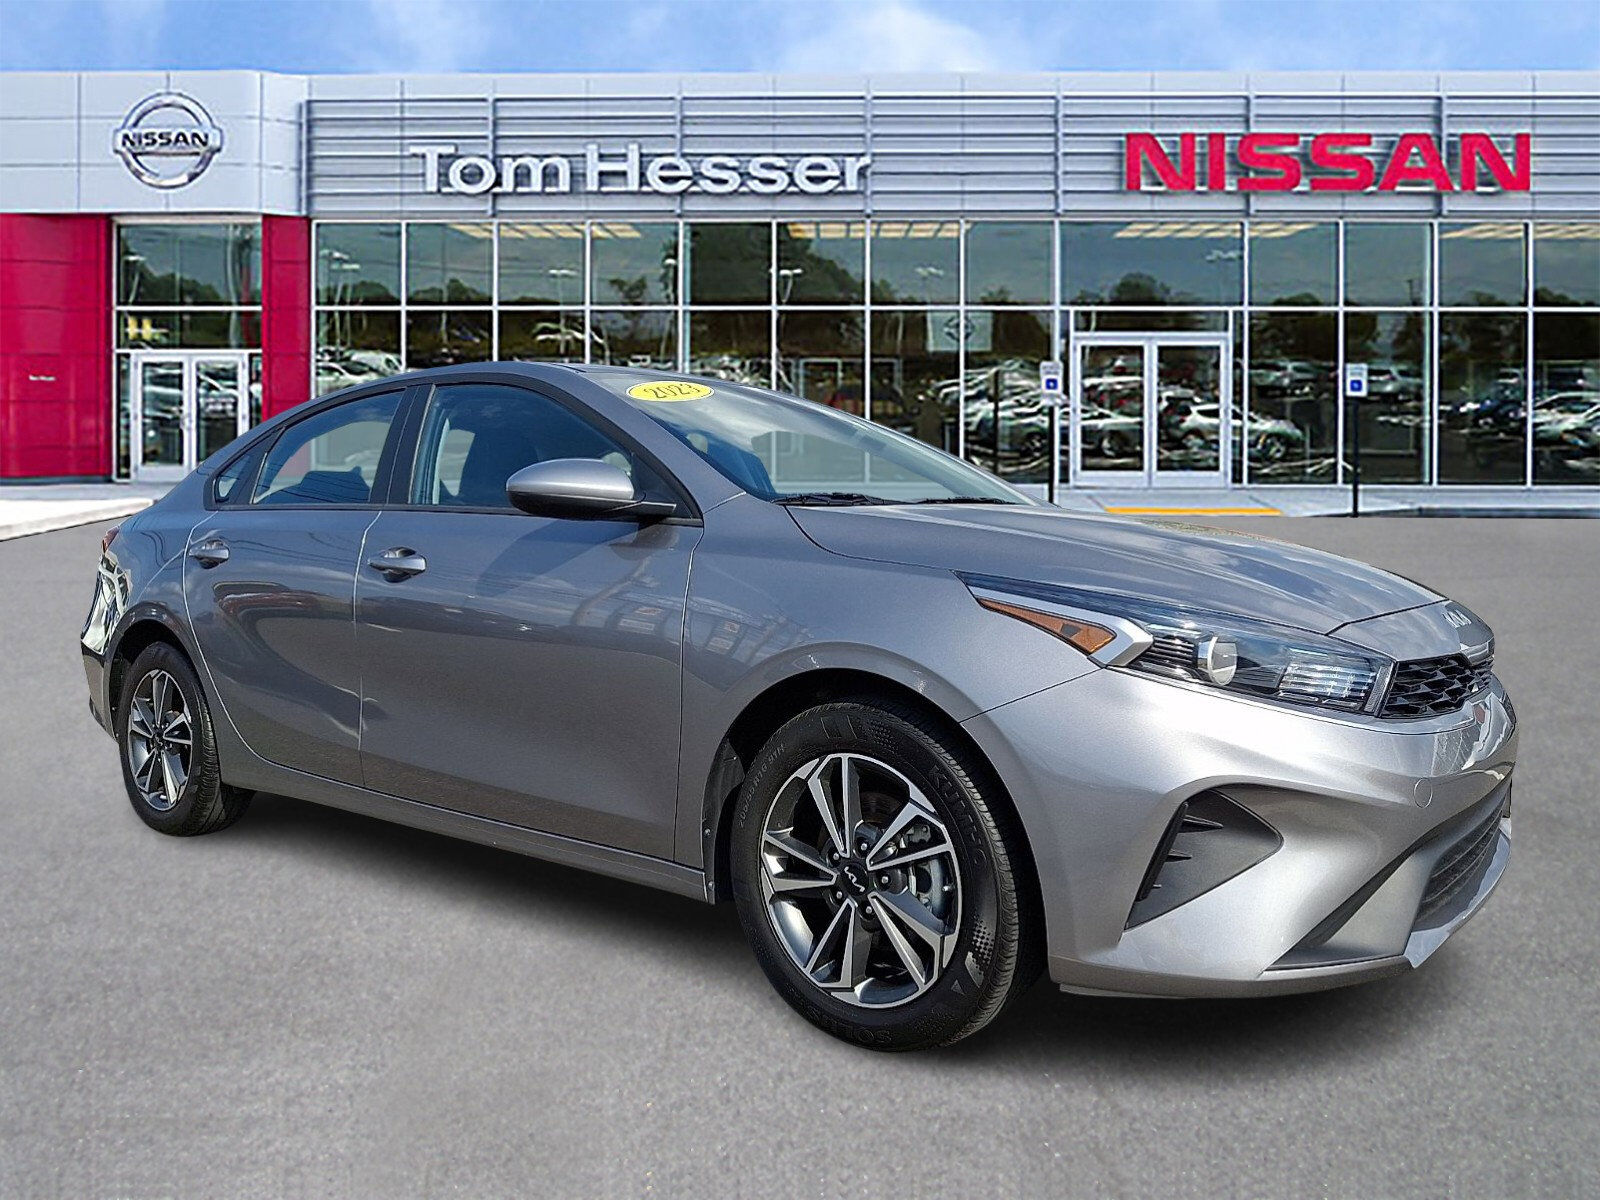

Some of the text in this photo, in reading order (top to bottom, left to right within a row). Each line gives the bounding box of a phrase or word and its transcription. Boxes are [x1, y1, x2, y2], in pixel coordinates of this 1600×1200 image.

[122, 131, 209, 147] NISSAN
[1124, 132, 1531, 192] NISSAN
[408, 142, 871, 195] Tom Hesser
